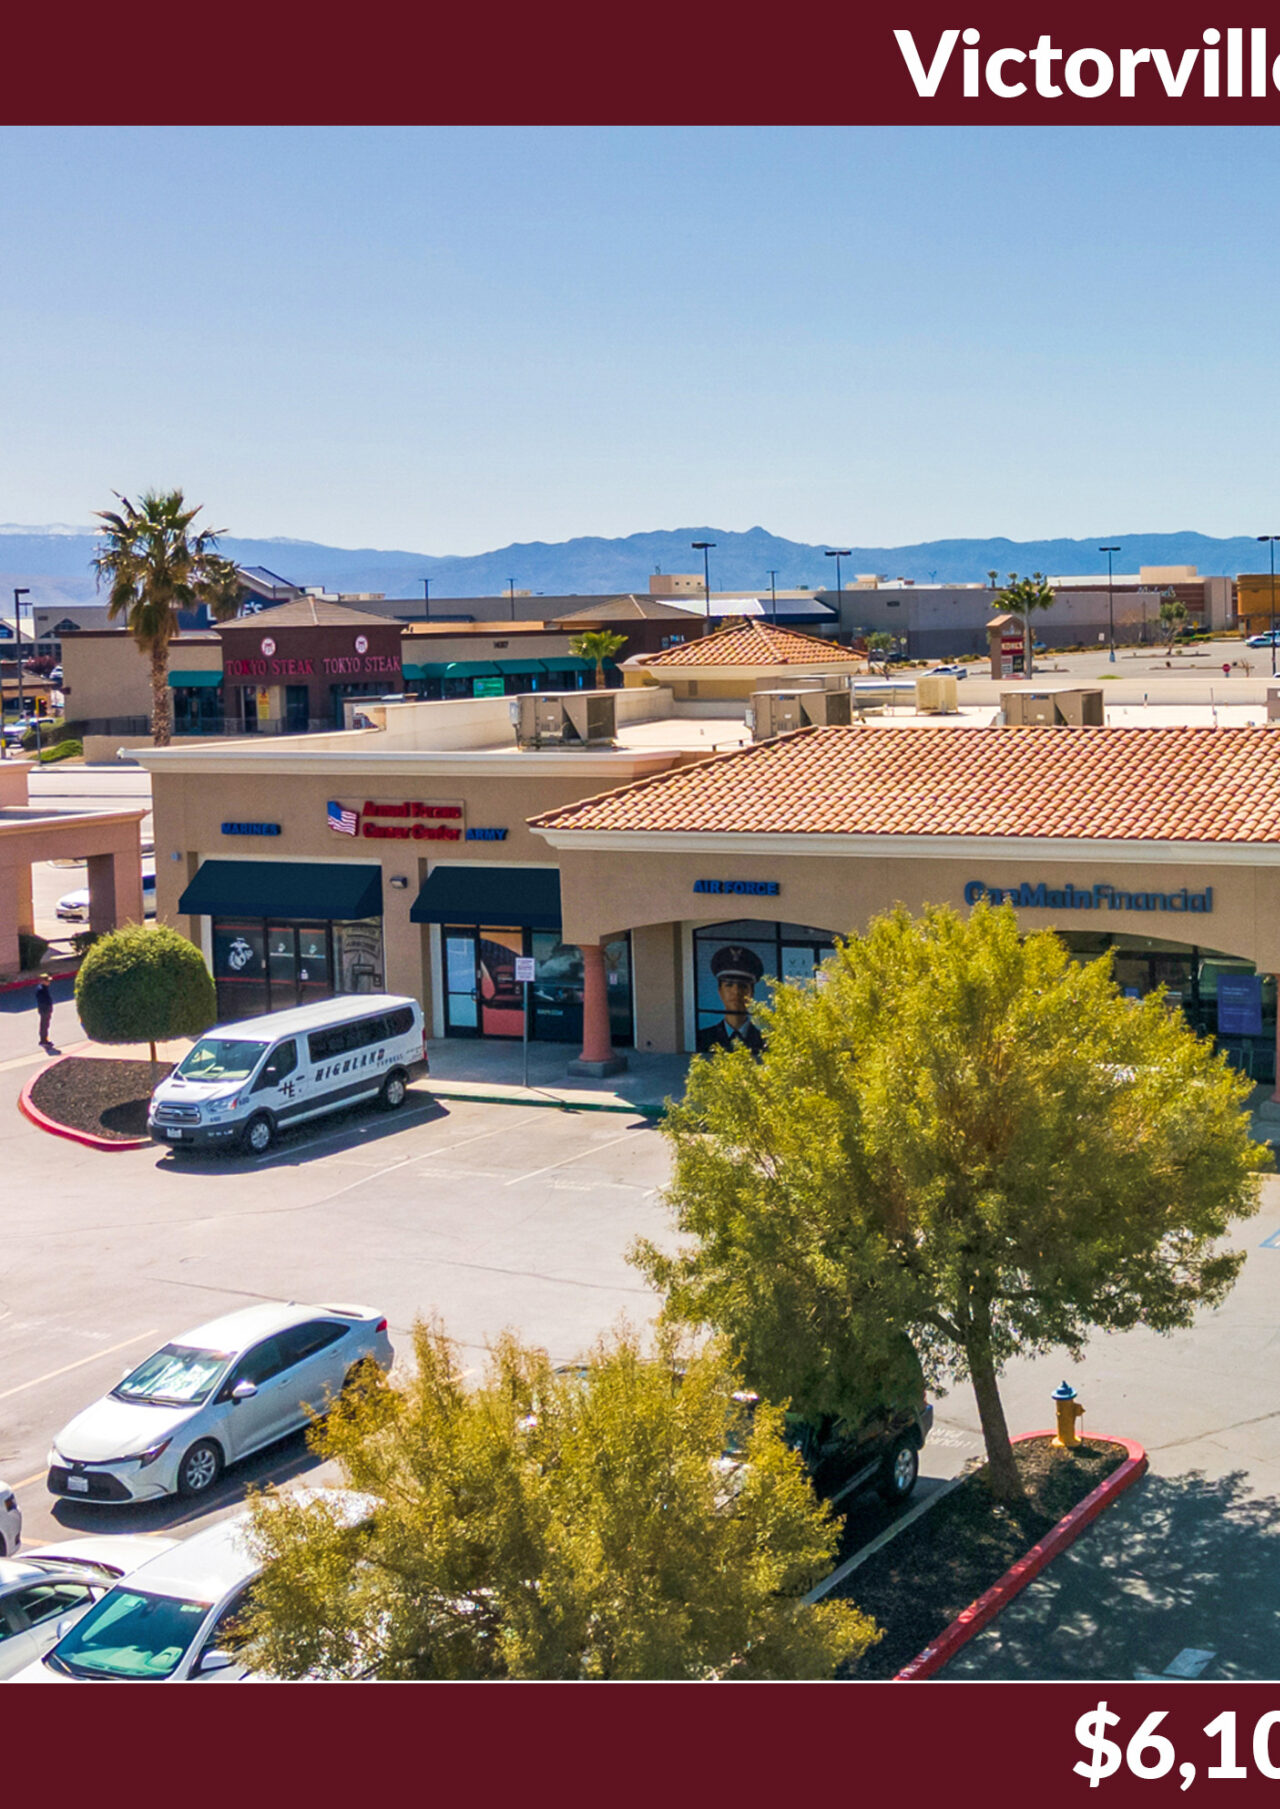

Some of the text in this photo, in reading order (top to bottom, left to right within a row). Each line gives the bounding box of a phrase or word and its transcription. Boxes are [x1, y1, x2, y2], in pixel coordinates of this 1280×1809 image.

[206, 601, 264, 622] LE'S
[226, 659, 313, 676] TOKYO STEAK
[323, 655, 401, 674] TOKYO STEAK
[362, 801, 462, 819] Armed Forces
[221, 822, 281, 836] MARINES
[362, 822, 462, 841] Career Center
[465, 828, 508, 841] ARMY
[693, 880, 779, 897] AIR FORCE
[964, 880, 1214, 914] OneMainFinancial
[315, 1048, 385, 1082] HIGHLAND
